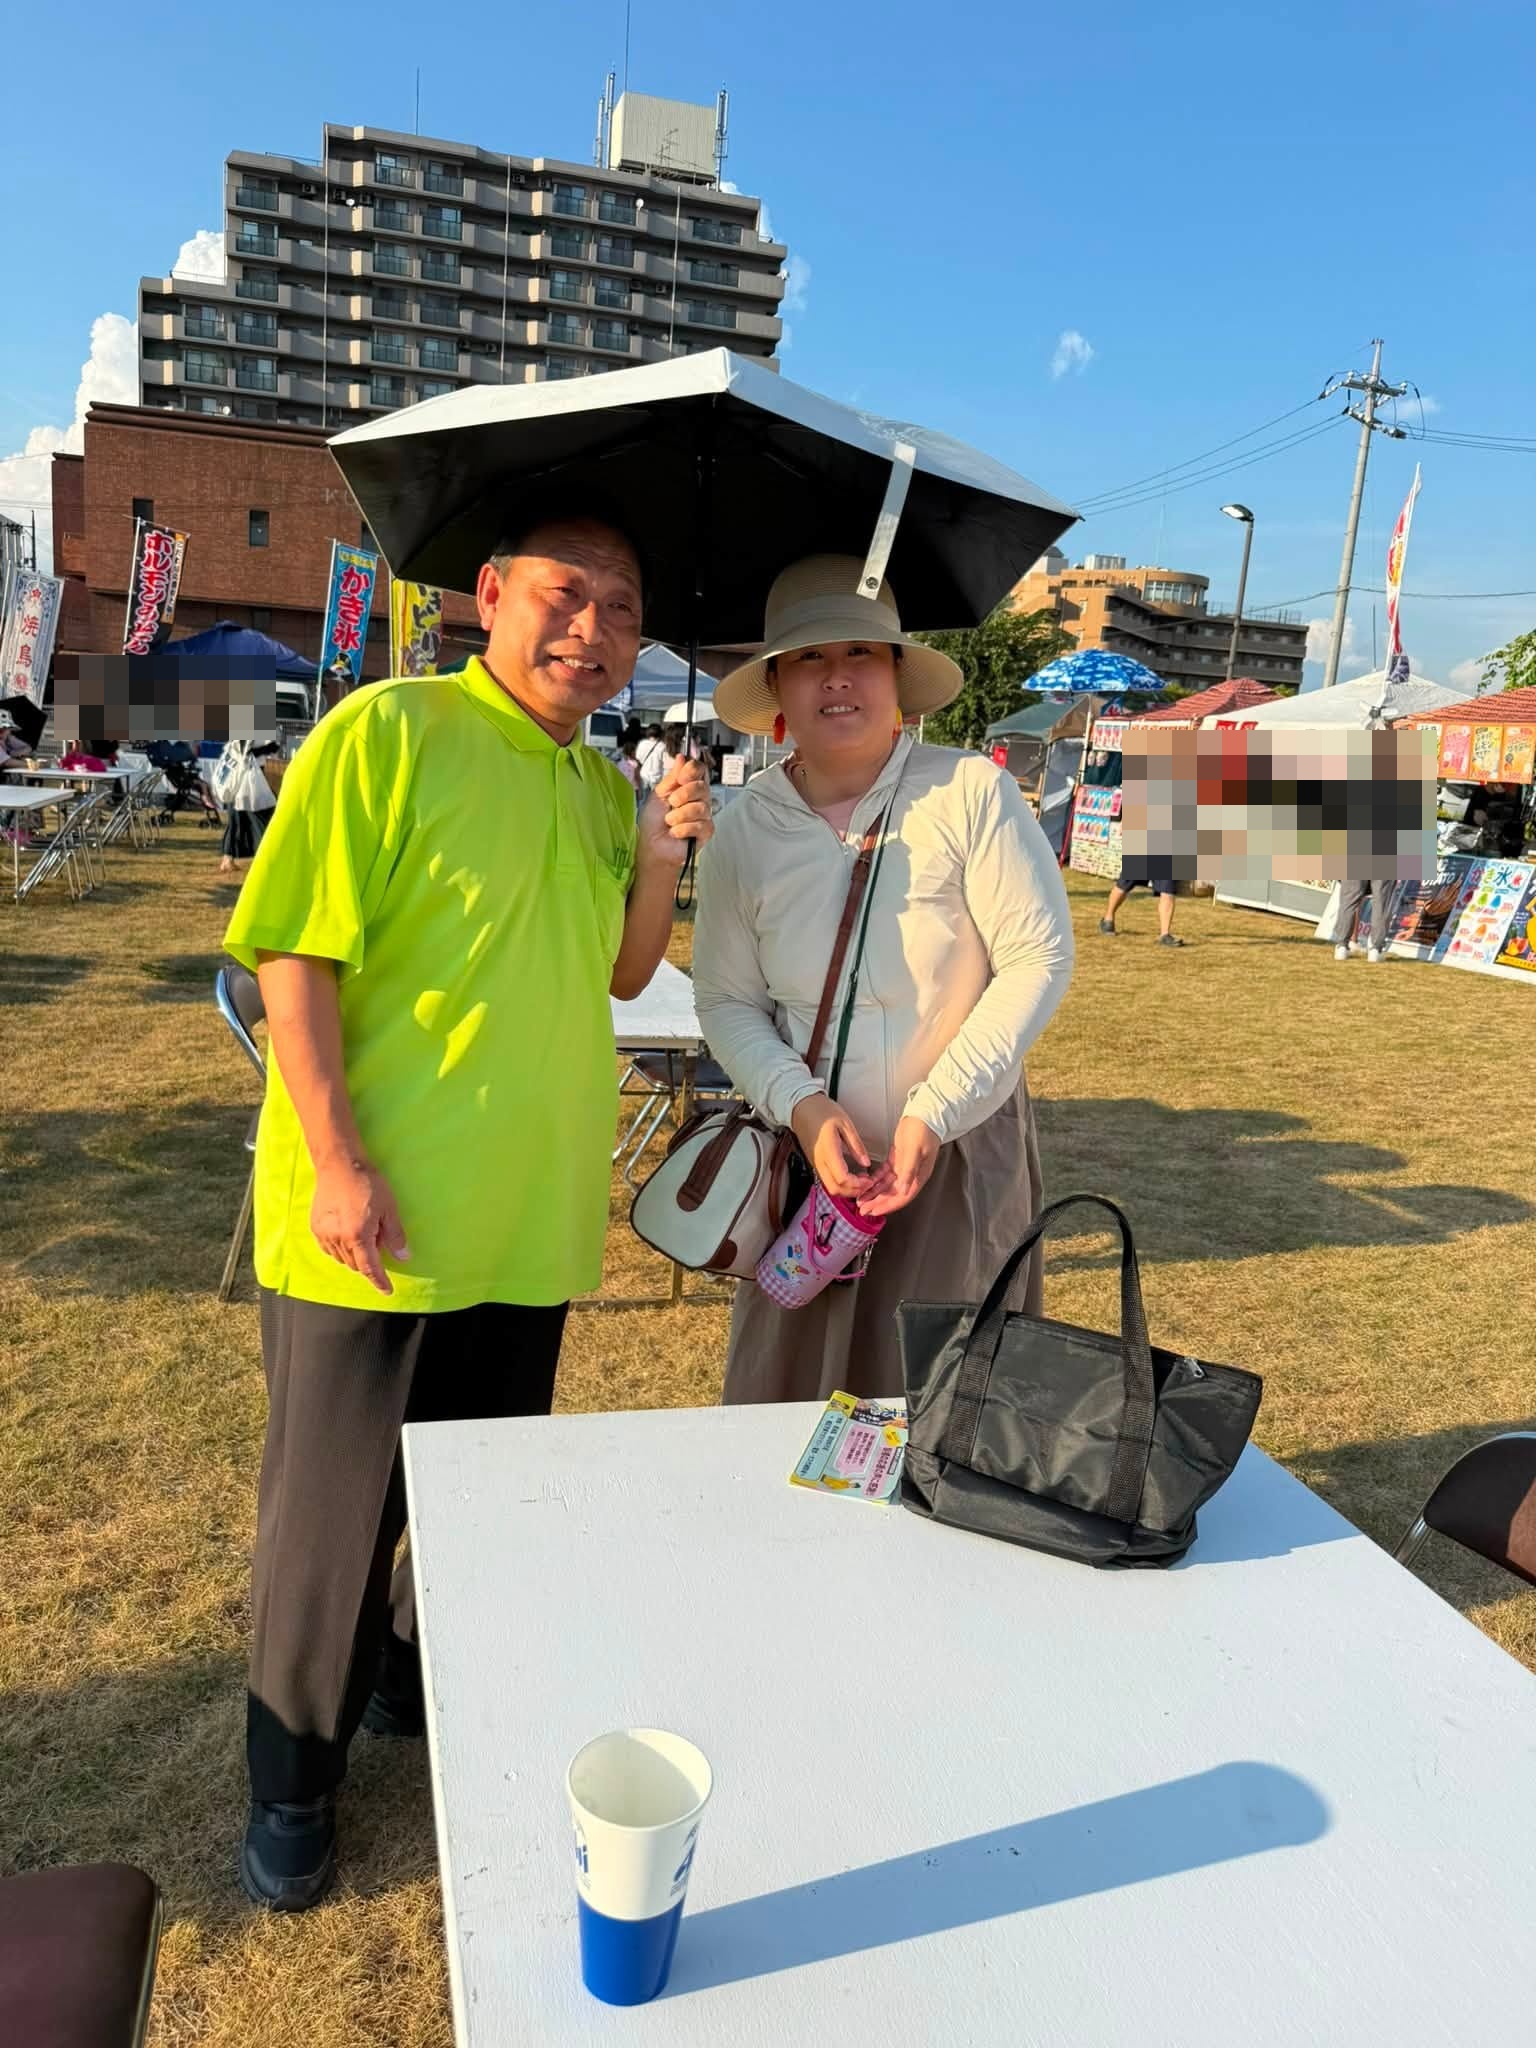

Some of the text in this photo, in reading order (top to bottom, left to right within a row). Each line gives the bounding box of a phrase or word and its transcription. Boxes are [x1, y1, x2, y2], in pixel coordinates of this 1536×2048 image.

[333, 565, 370, 652] かき氷
[1470, 866, 1513, 886] かき氷
